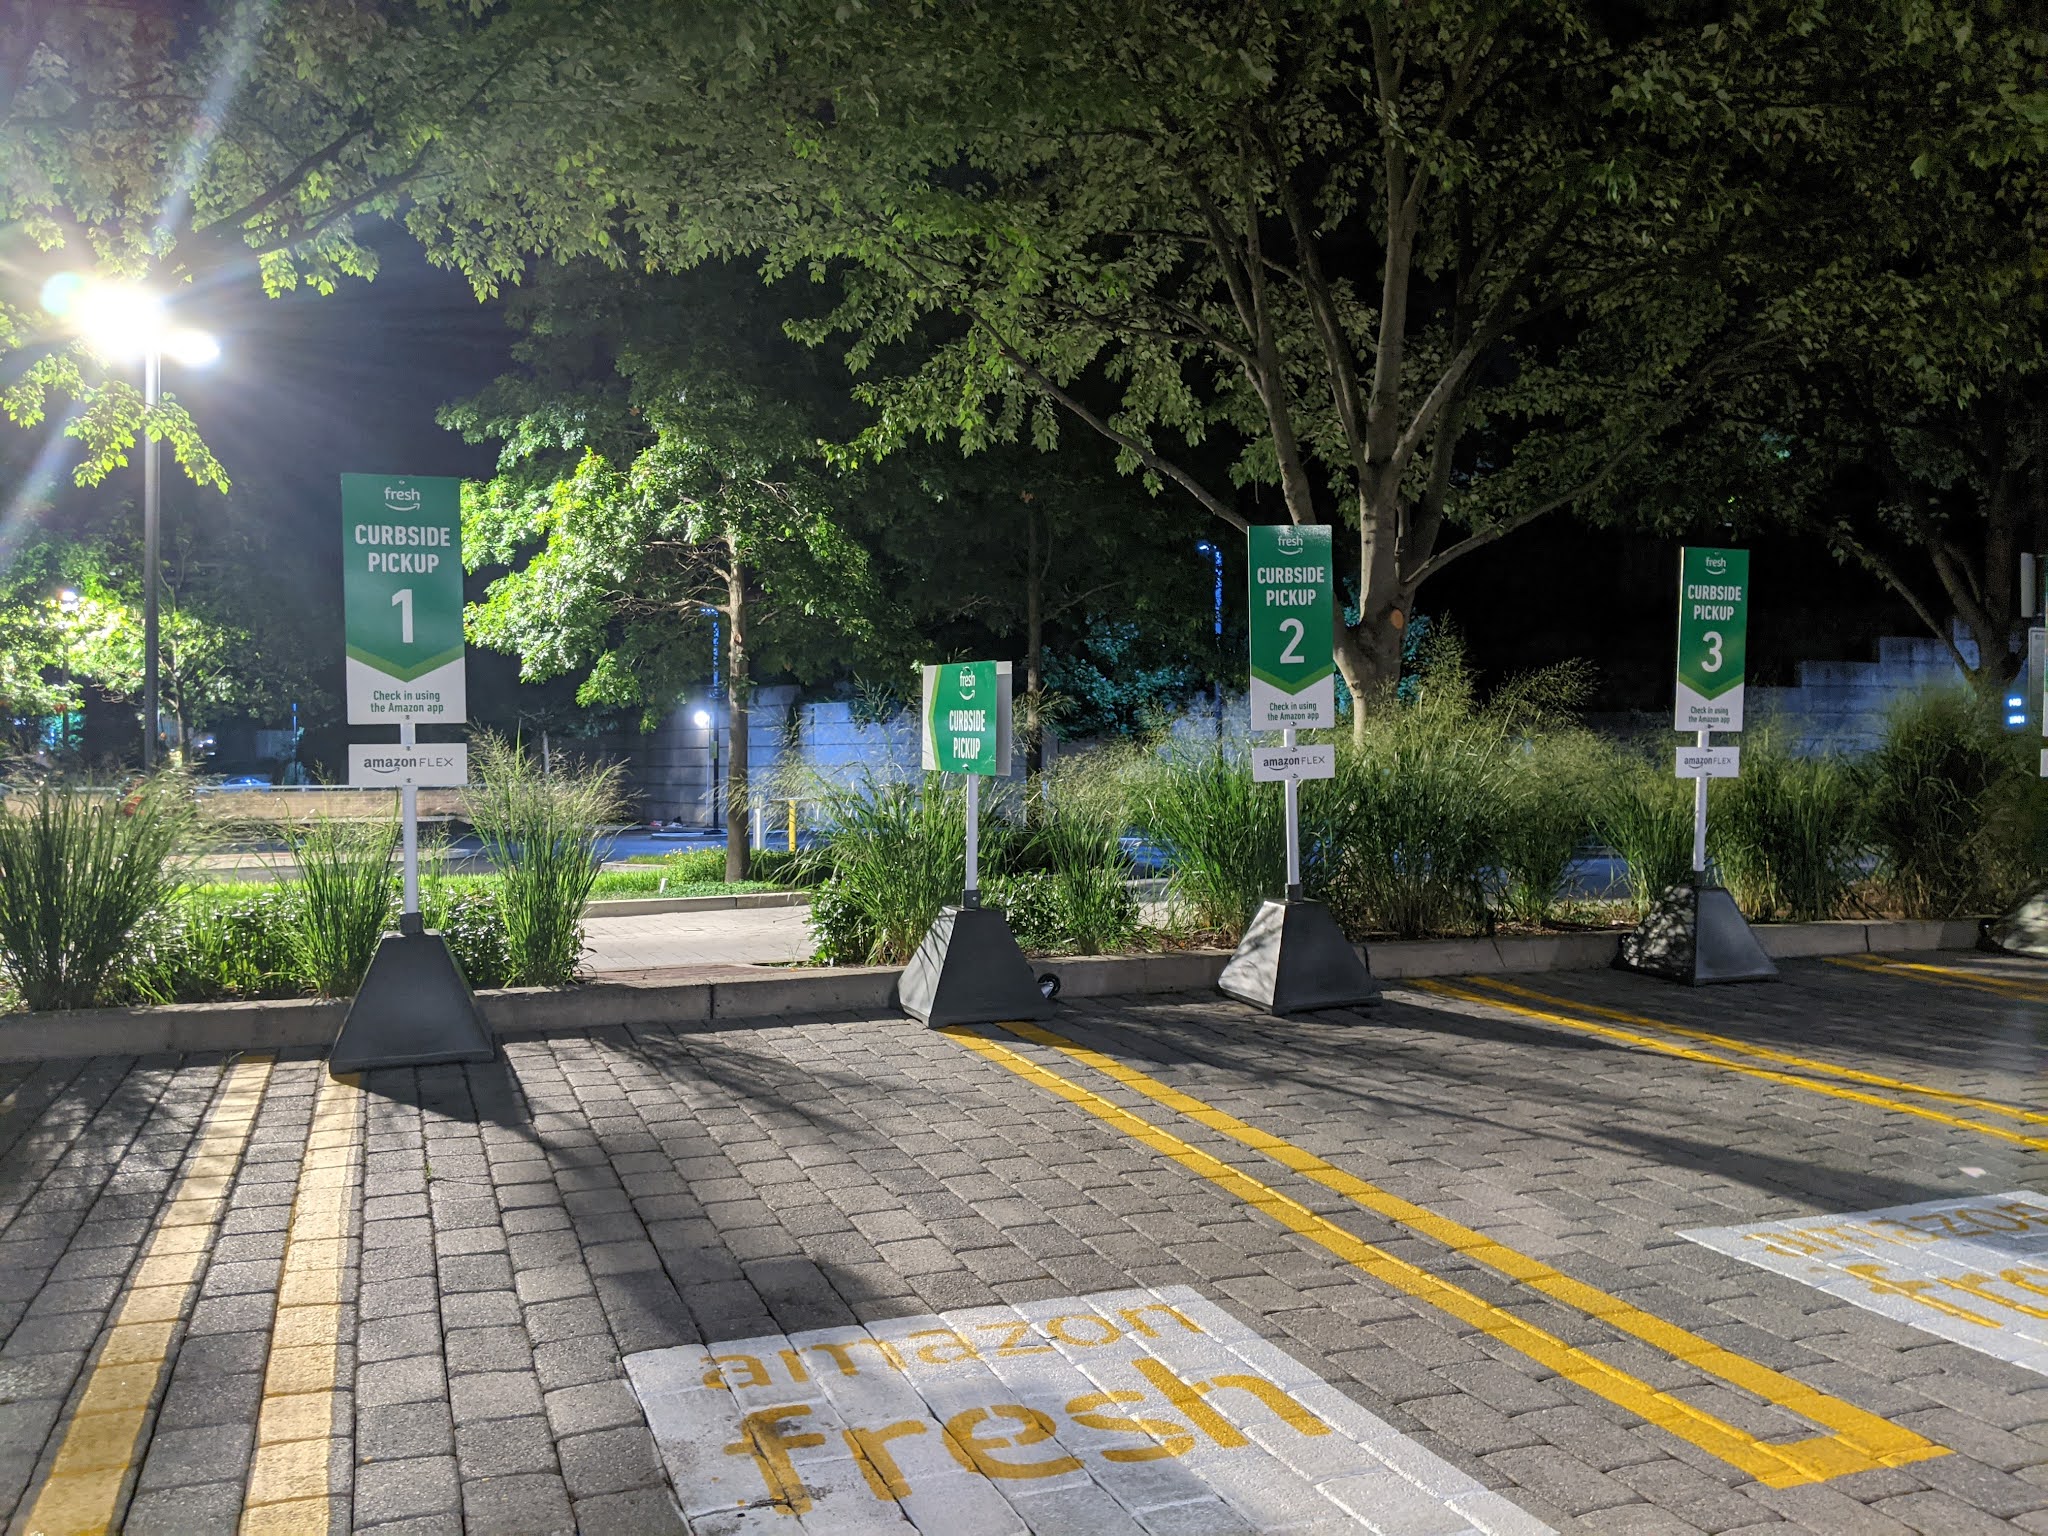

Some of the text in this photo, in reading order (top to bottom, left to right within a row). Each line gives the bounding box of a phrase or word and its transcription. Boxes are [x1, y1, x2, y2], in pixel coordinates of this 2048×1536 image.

[384, 487, 420, 501] fresh
[355, 524, 451, 547] CURBSIDE
[1278, 535, 1304, 547] fresh
[368, 552, 440, 574] PICKUP
[1705, 556, 1727, 568] fresh
[1257, 566, 1325, 584] CURBSIDE
[1266, 589, 1317, 606] PICKUP
[1687, 584, 1742, 601] CURBSIDE
[391, 588, 414, 644] 1
[1693, 604, 1735, 621] PICKUP
[1279, 617, 1305, 664] 2
[1701, 631, 1723, 673] 3
[960, 670, 976, 687] fresh
[373, 690, 441, 702] Check in using
[370, 703, 444, 714] the Amazon app
[1269, 701, 1317, 712] Check in using
[1690, 706, 1729, 716] Check in using
[949, 709, 986, 732] CURBSIDE
[1267, 712, 1320, 722] the Amazon app
[1688, 715, 1731, 724] the Amazon app
[953, 737, 981, 759] PICKUP
[363, 757, 454, 769] amazon FLEX
[1263, 756, 1326, 767] amazon FLEX
[1684, 757, 1732, 766] amazon FLEX
[701, 1303, 1203, 1390] amazon
[724, 1355, 1334, 1517] fresh
